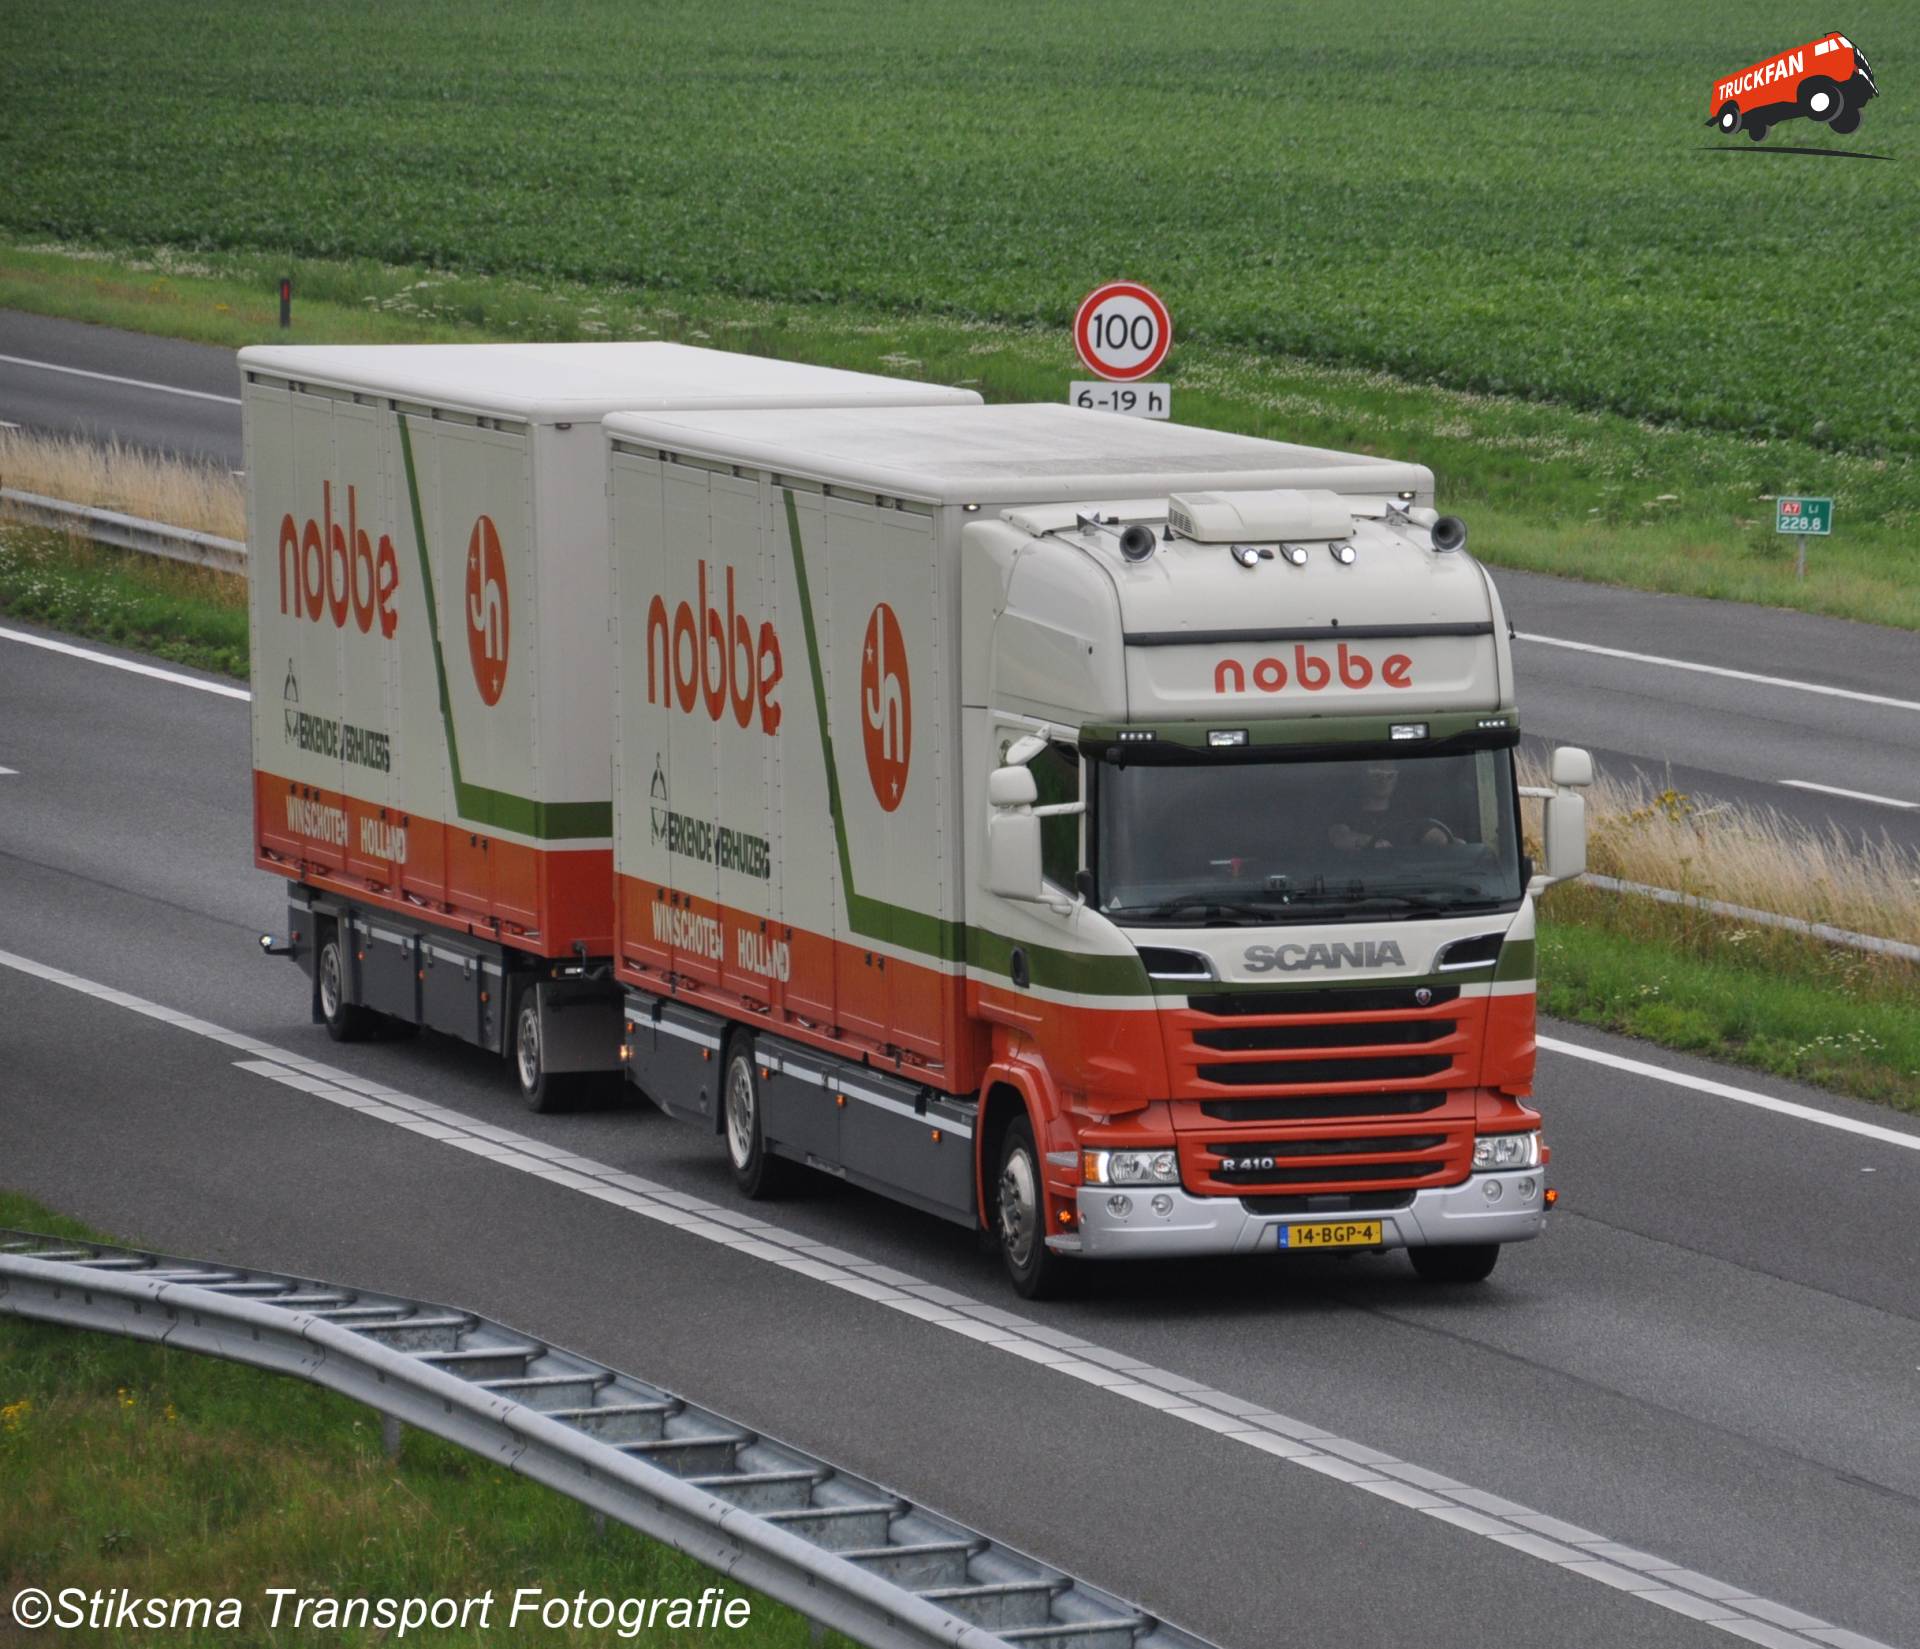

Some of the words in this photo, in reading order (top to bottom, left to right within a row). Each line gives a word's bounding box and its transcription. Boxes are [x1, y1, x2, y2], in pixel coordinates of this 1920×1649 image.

[1093, 313, 1154, 351] 100
[1077, 389, 1137, 411] 6-19
[1148, 391, 1162, 412] h
[1784, 503, 1799, 513] A7
[279, 480, 398, 640] nobbe
[646, 559, 783, 736] nobbe
[1214, 643, 1413, 694] nobbe
[299, 712, 339, 760] ERKENDE
[286, 795, 349, 847] WINSCHOTEN
[360, 816, 408, 865] HOLLAND
[668, 811, 713, 864] ERKENDE
[652, 901, 724, 962] WINSCHOTEN
[737, 928, 791, 984] HOLLAND
[1243, 940, 1406, 973] SCANIA
[1222, 1159, 1236, 1171] R
[1239, 1157, 1275, 1170] 410
[1297, 1225, 1373, 1244] 14-BGP-4
